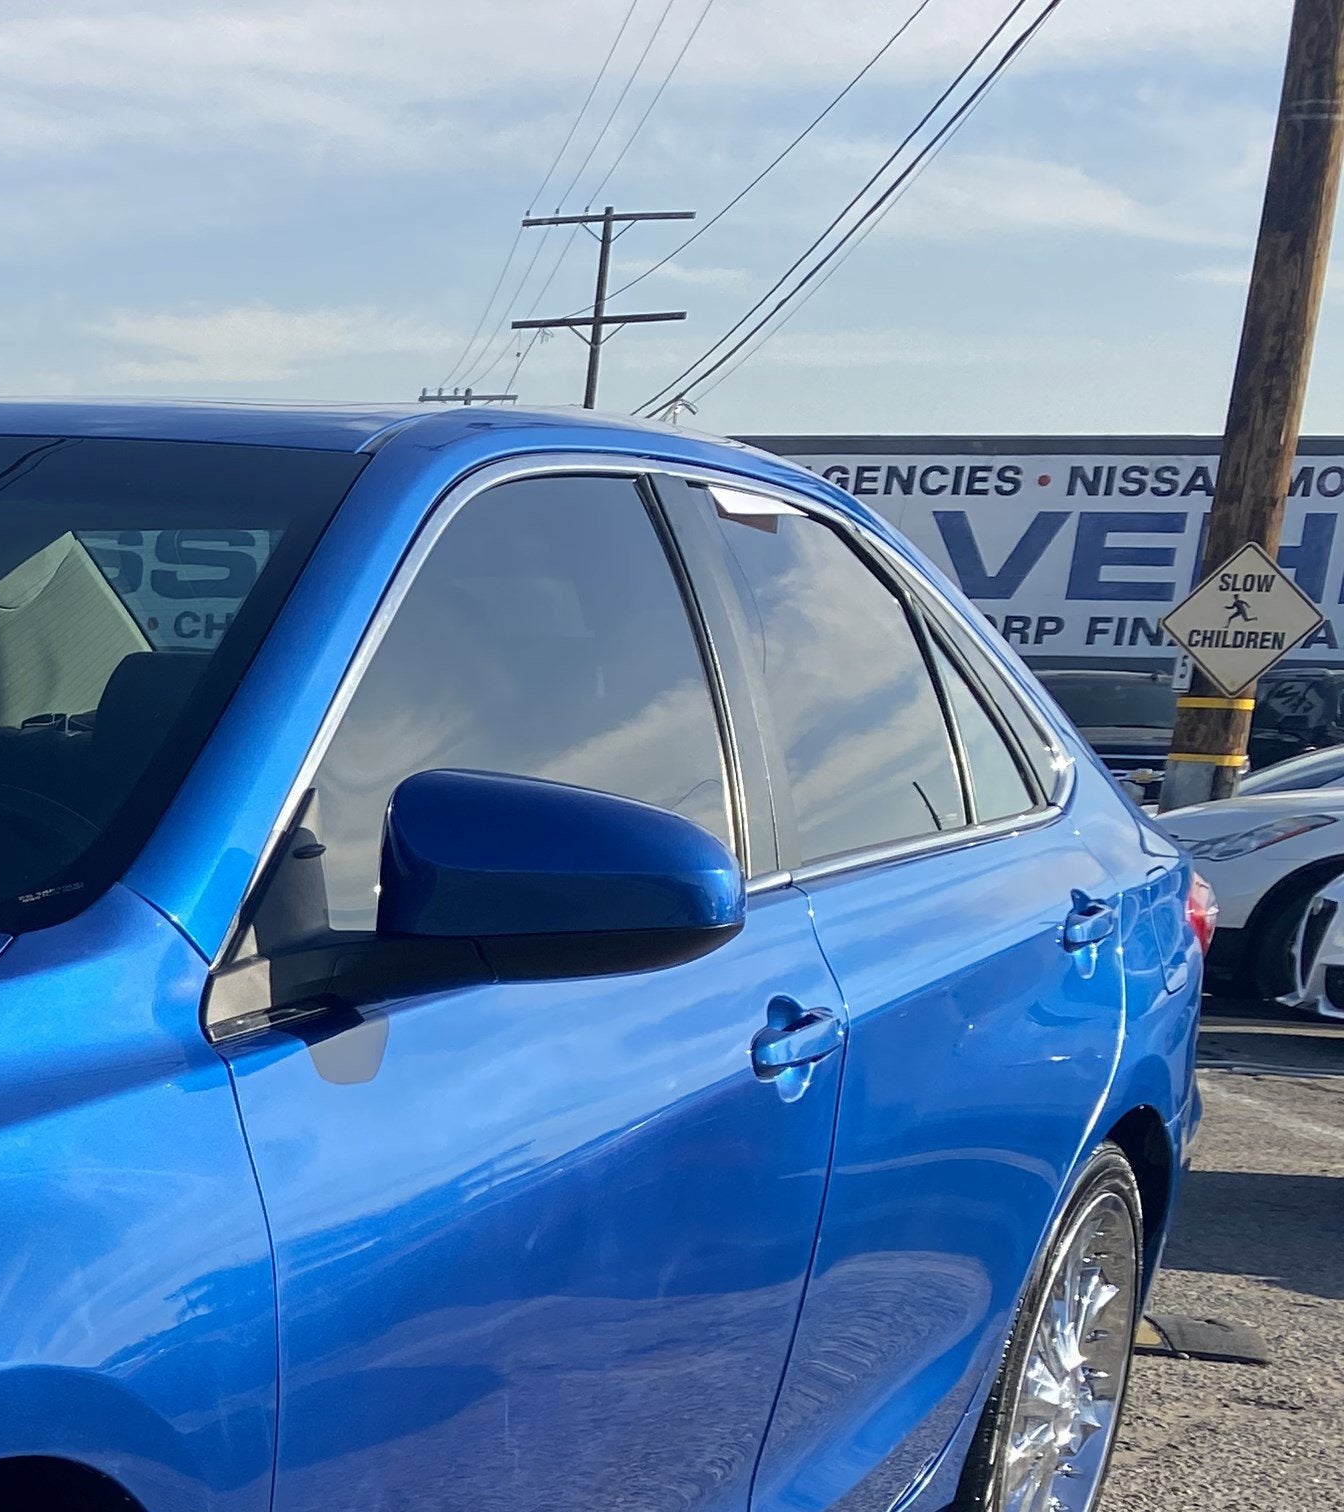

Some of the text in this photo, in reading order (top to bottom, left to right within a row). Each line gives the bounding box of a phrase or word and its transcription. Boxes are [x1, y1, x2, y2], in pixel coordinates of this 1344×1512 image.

[808, 465, 1024, 496] GENCIES
[1066, 465, 1214, 497] NISSA
[932, 510, 1344, 605] VEH
[1218, 573, 1276, 593] SLOW
[1187, 629, 1286, 650] CHILDREN
